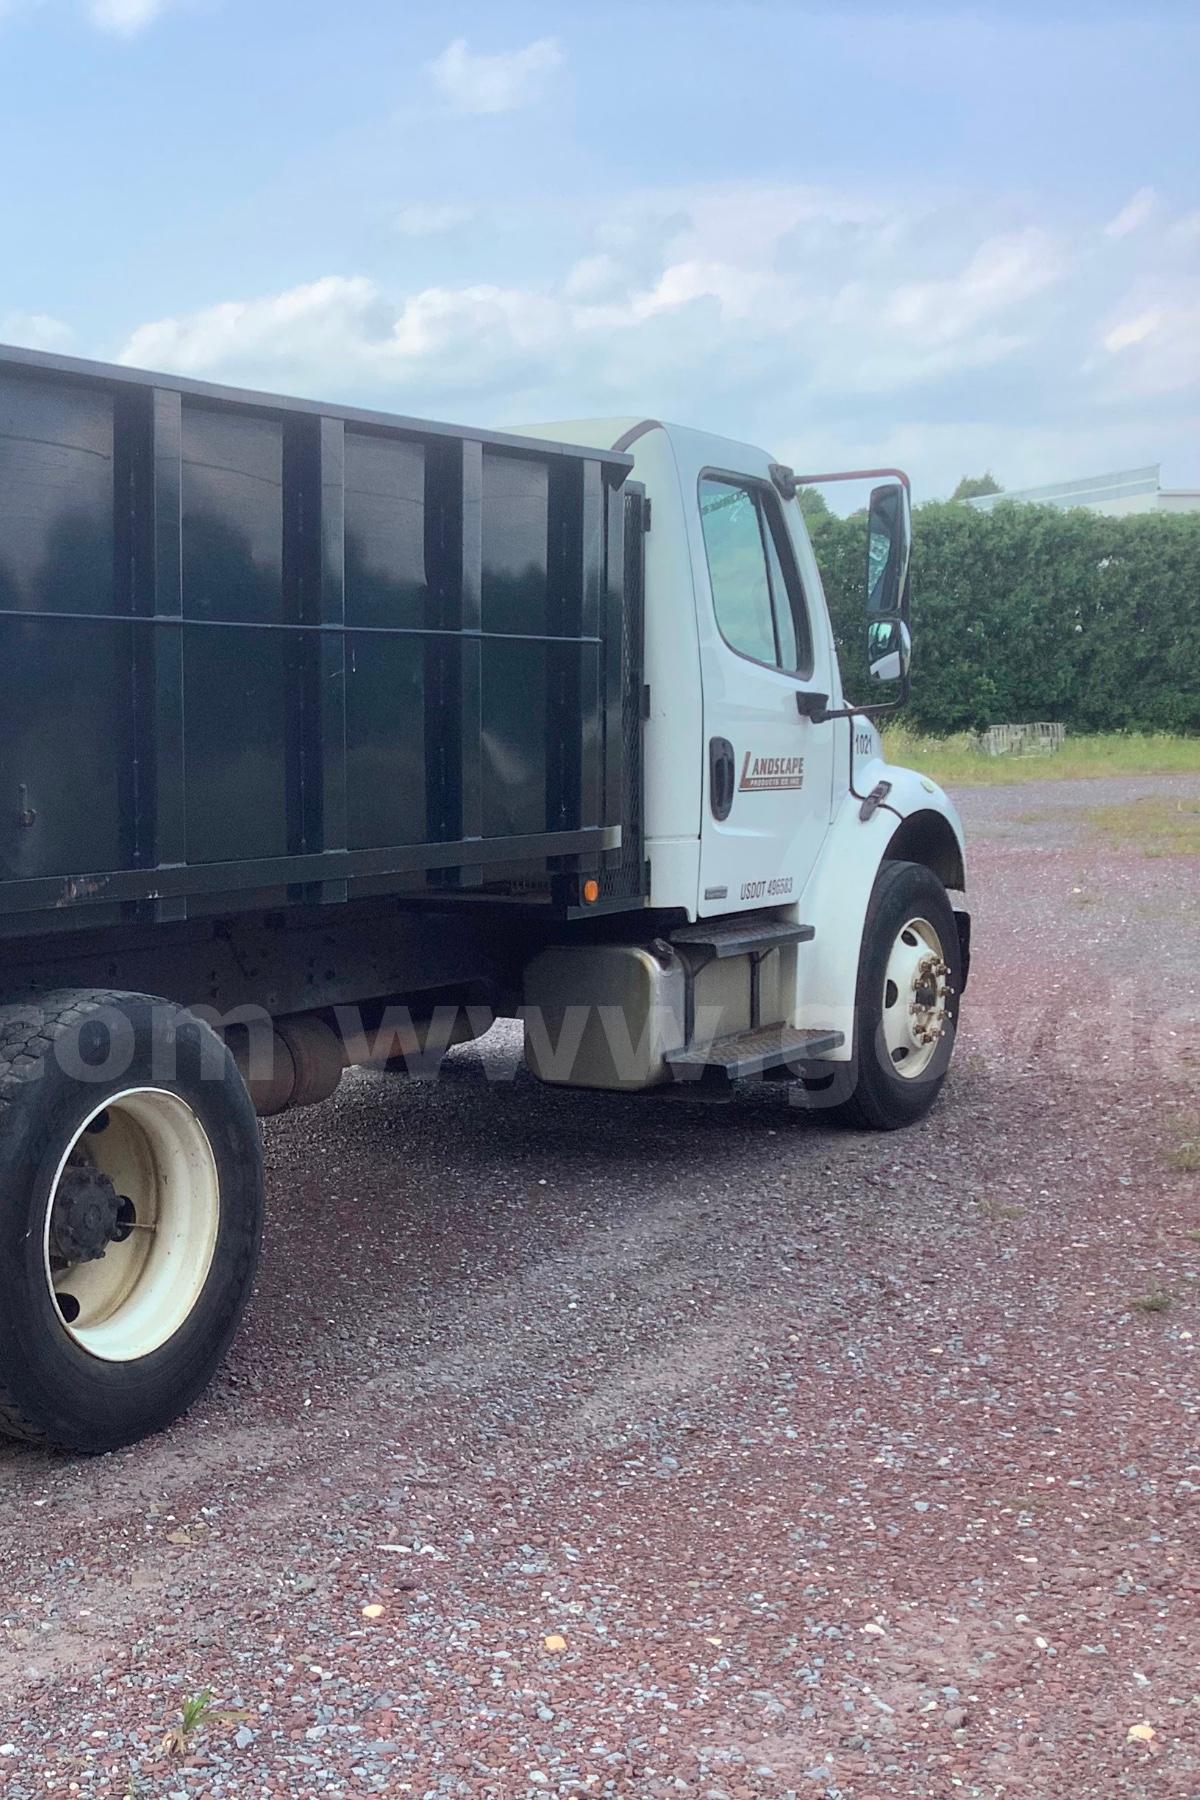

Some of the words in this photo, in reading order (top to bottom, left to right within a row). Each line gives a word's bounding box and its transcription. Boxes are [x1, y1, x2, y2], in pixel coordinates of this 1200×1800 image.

[855, 734, 872, 755] 1021
[739, 751, 804, 786] LANDSCAPE
[740, 880, 766, 901] USDOT
